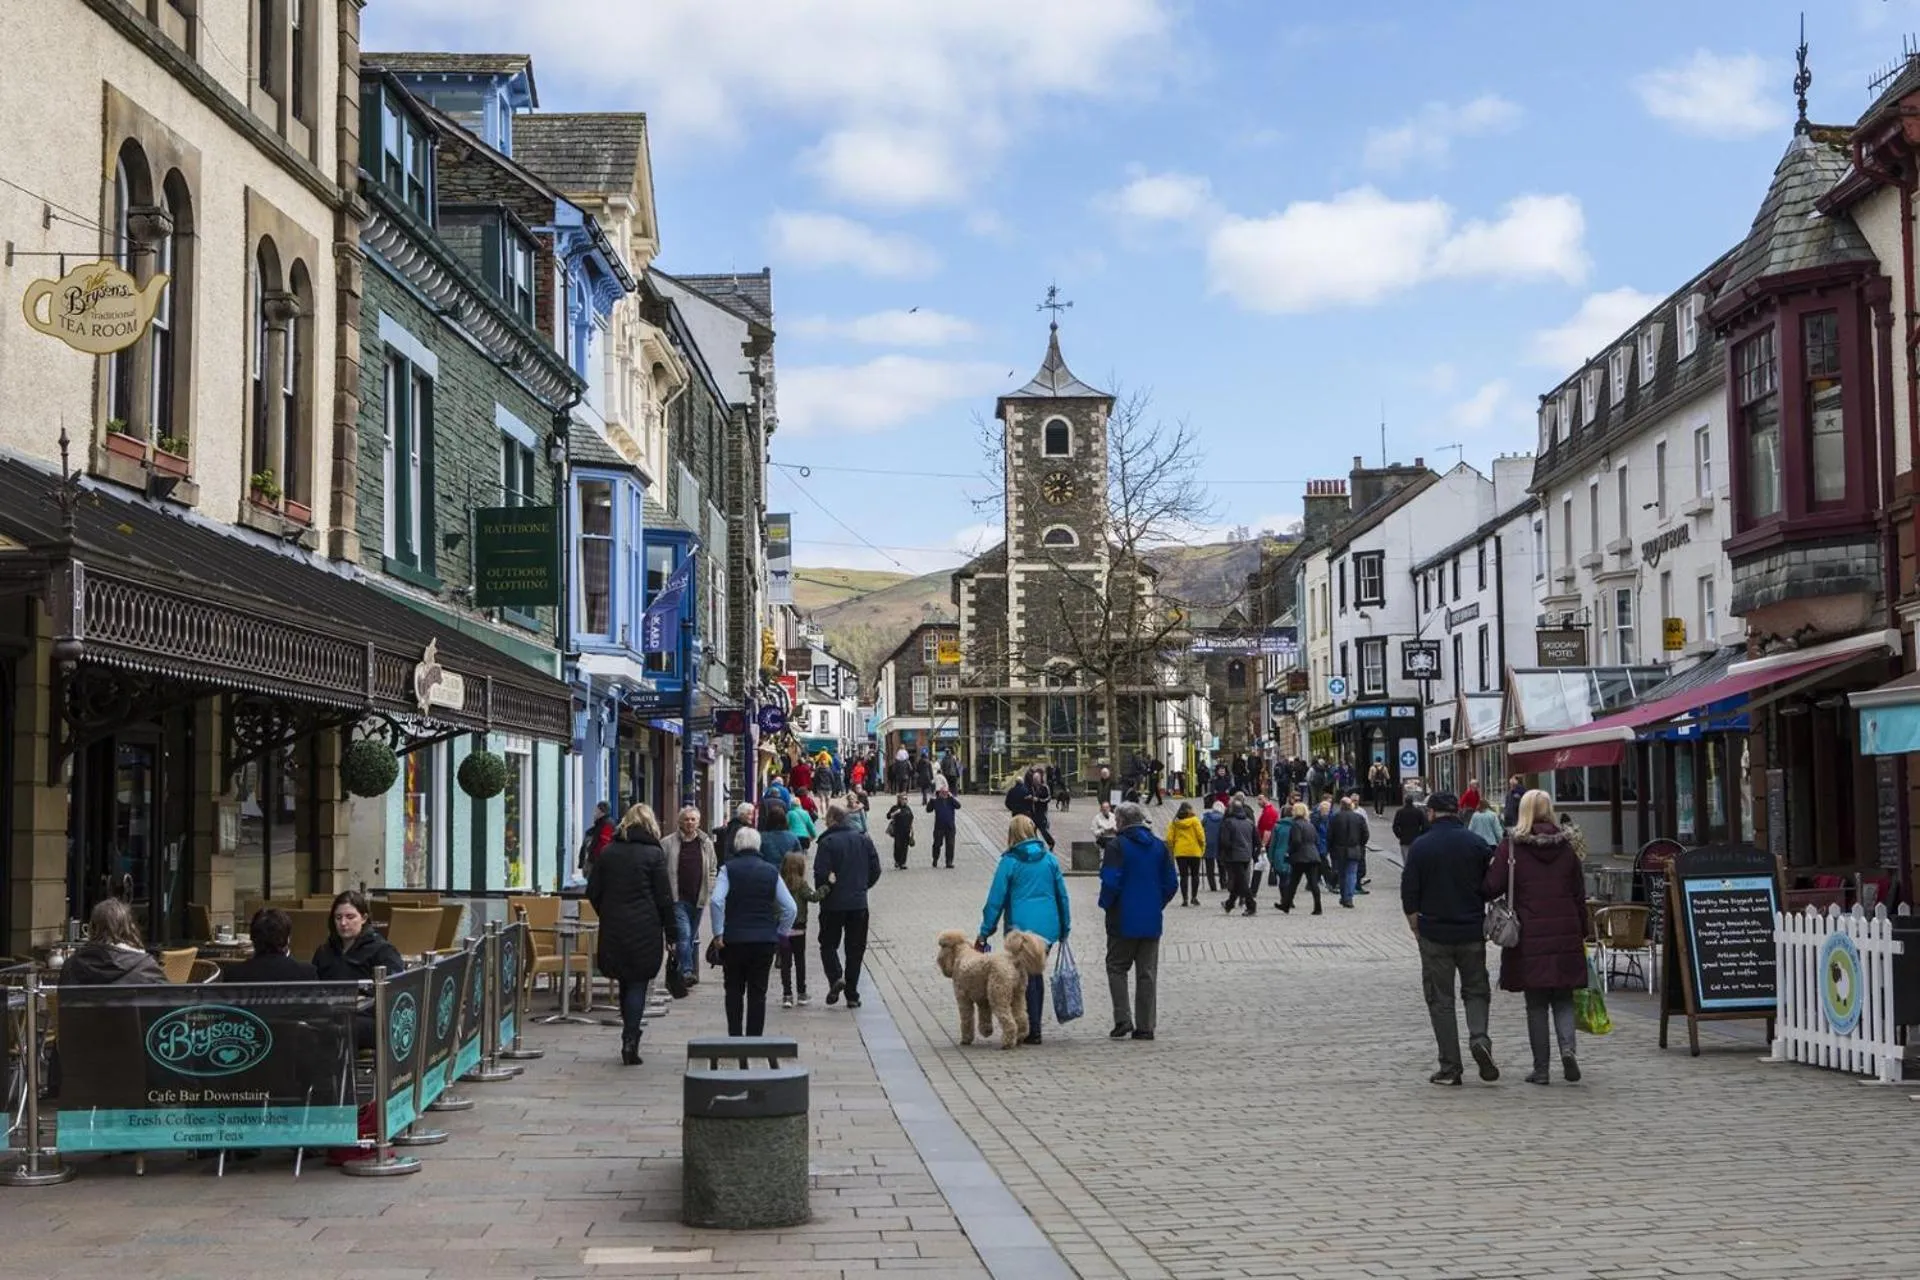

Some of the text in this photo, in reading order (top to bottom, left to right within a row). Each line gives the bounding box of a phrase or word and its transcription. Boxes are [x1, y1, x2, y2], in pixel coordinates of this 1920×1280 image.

[64, 284, 128, 317] Bryson's
[59, 315, 138, 338] TEA ROOM
[483, 523, 550, 534] RATHBONE
[487, 567, 547, 577] OUTDOOR
[486, 580, 549, 591] CLOTHING
[1548, 650, 1576, 658] HOTEL
[158, 1020, 256, 1061] Bryson's
[148, 1088, 270, 1102] Cafe Bar Downstairs
[128, 1114, 162, 1127] Fresh
[165, 1113, 206, 1126] Coffee
[173, 1129, 244, 1143] Cream Teas
